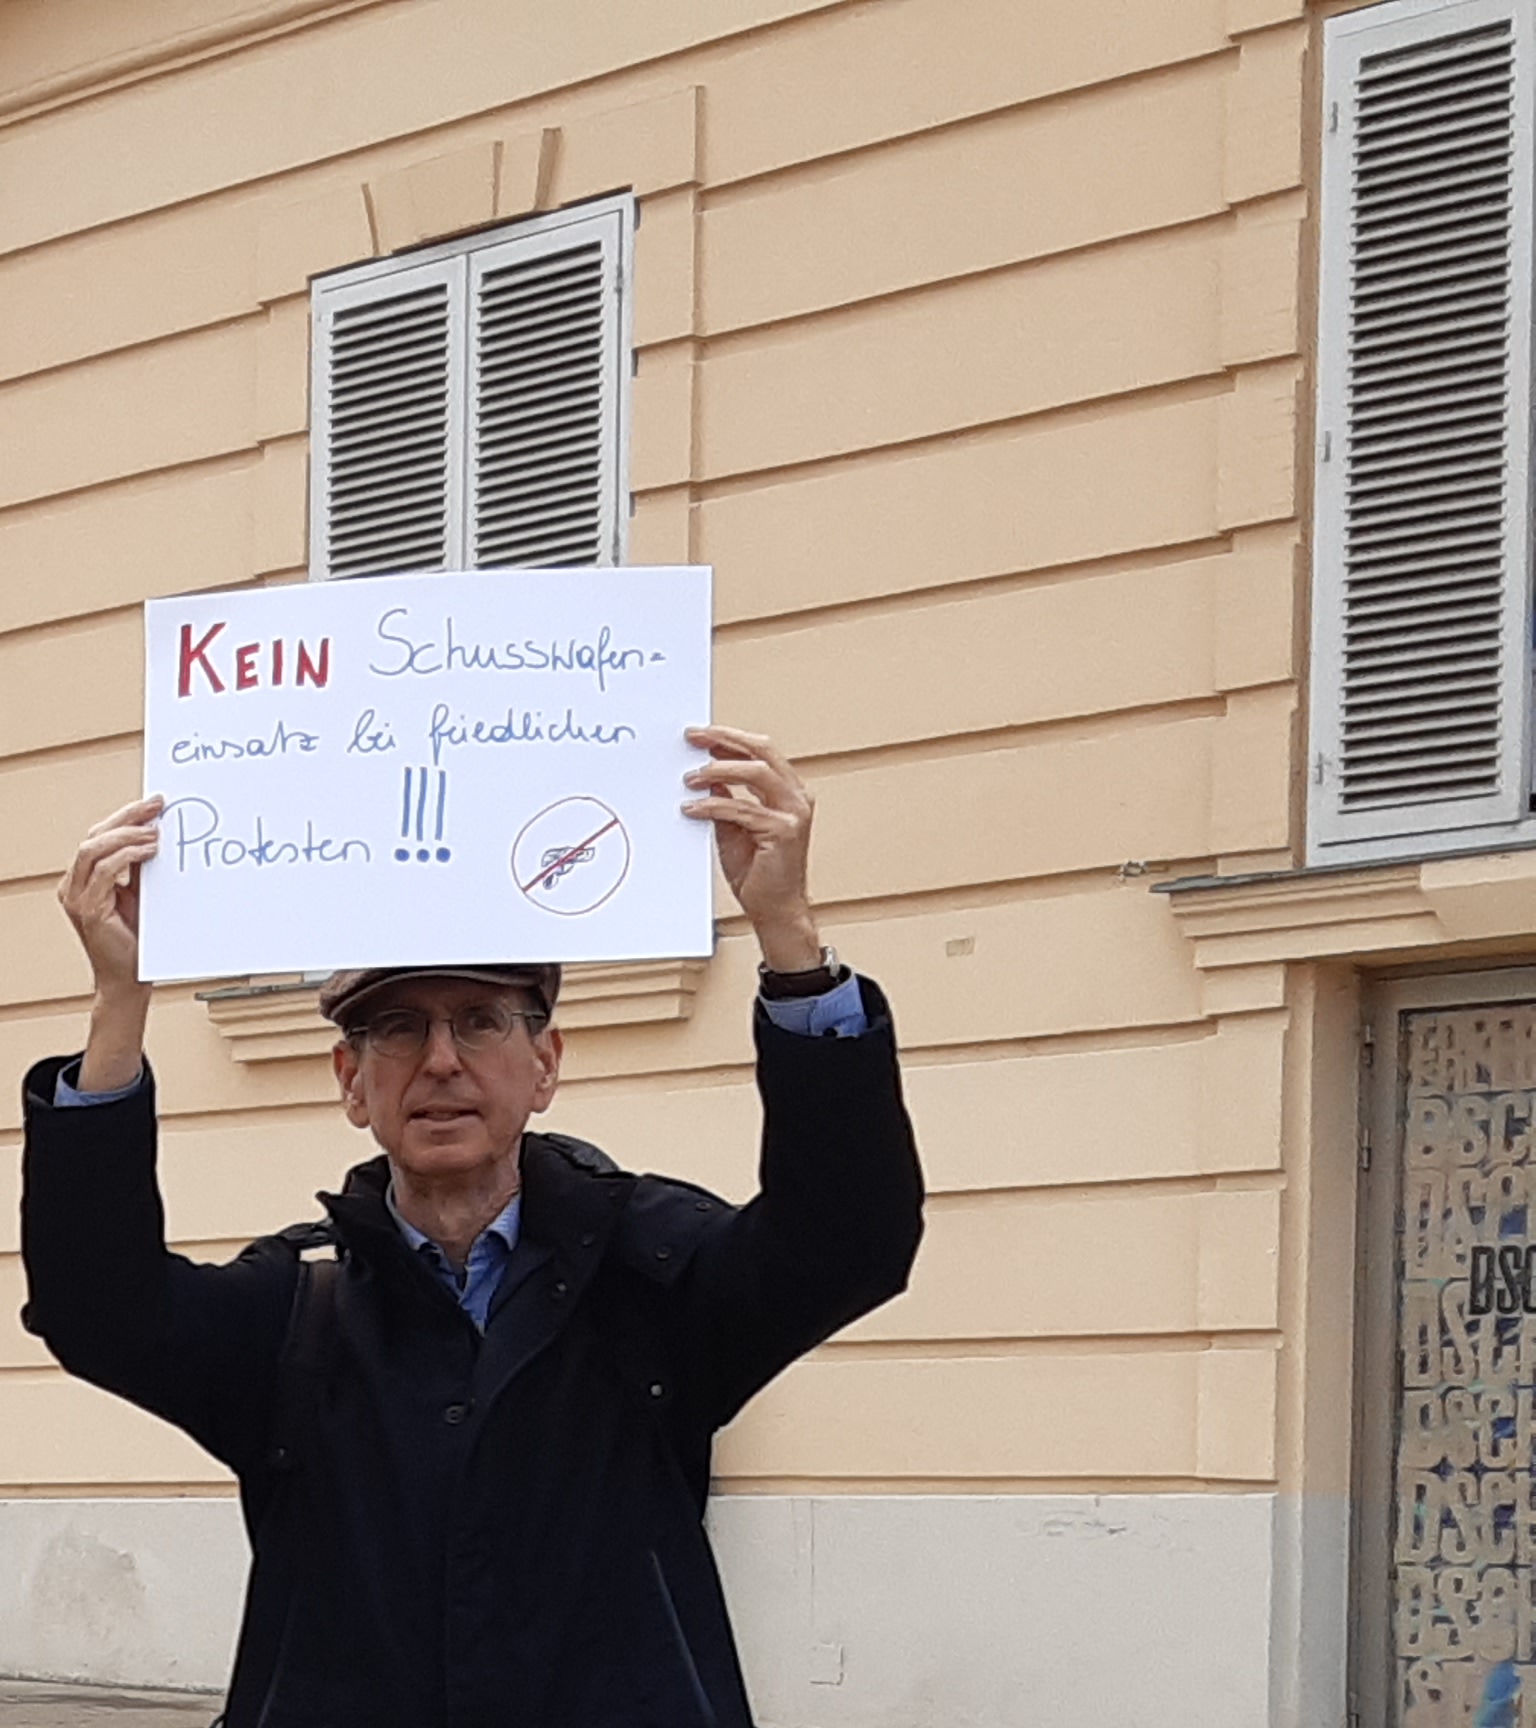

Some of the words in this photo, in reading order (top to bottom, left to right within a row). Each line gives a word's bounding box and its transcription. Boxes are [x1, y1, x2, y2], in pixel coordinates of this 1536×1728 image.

[178, 620, 330, 698] KEIN
[347, 708, 397, 754] bei
[428, 703, 637, 766] friedlichen
[159, 797, 371, 873] Protesten
